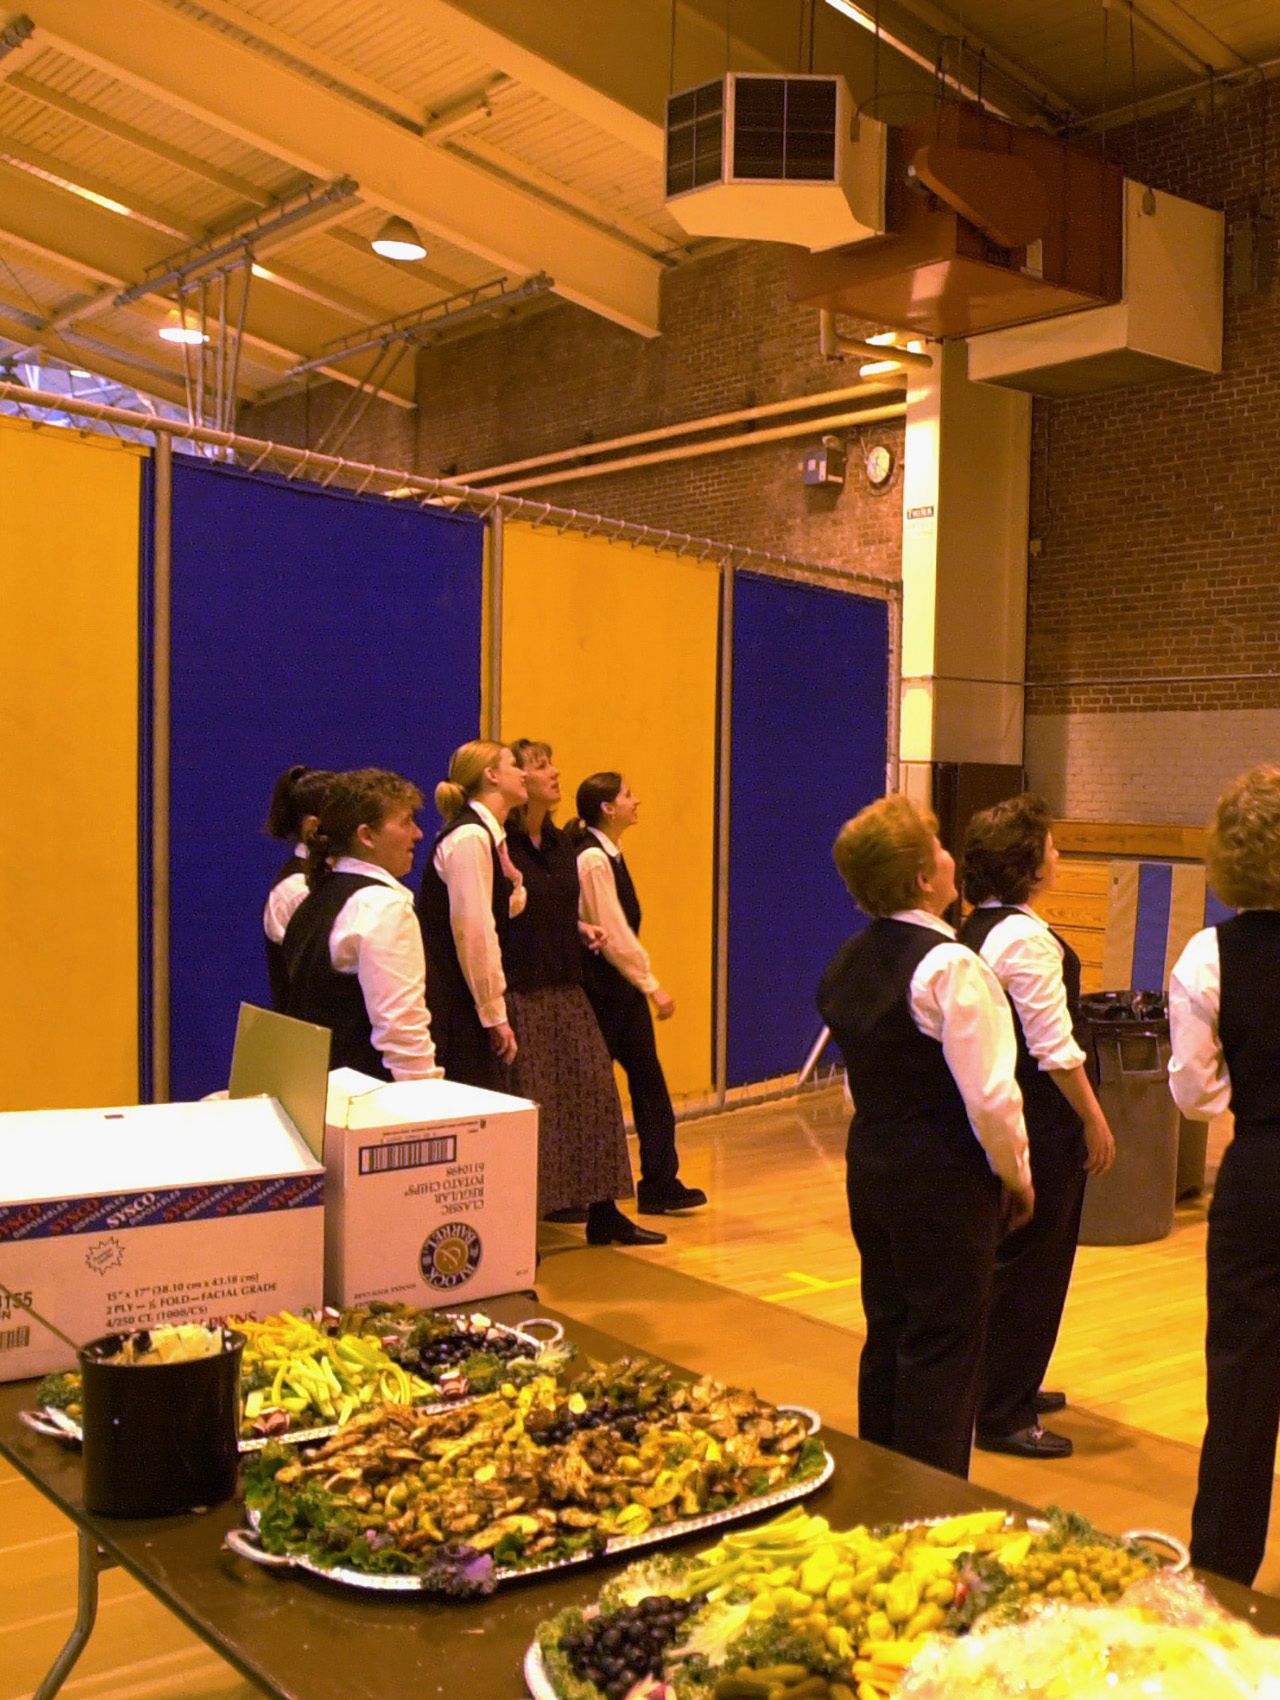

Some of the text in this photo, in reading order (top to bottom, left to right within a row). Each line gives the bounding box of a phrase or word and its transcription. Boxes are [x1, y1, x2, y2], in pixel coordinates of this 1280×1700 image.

[435, 1187, 484, 1204] REGULAR
[443, 1174, 484, 1191] POTATO
[106, 1192, 156, 1228] SYSCO
[163, 1186, 209, 1222] SYSCO
[216, 1182, 261, 1216] SYSCO
[441, 1199, 484, 1215] CLASSIC
[50, 1199, 99, 1232] SYSCO
[425, 1224, 477, 1248] BARREL
[426, 1264, 475, 1288] BLOCK
[114, 1303, 133, 1314] PLY
[241, 1282, 277, 1296] GRADE
